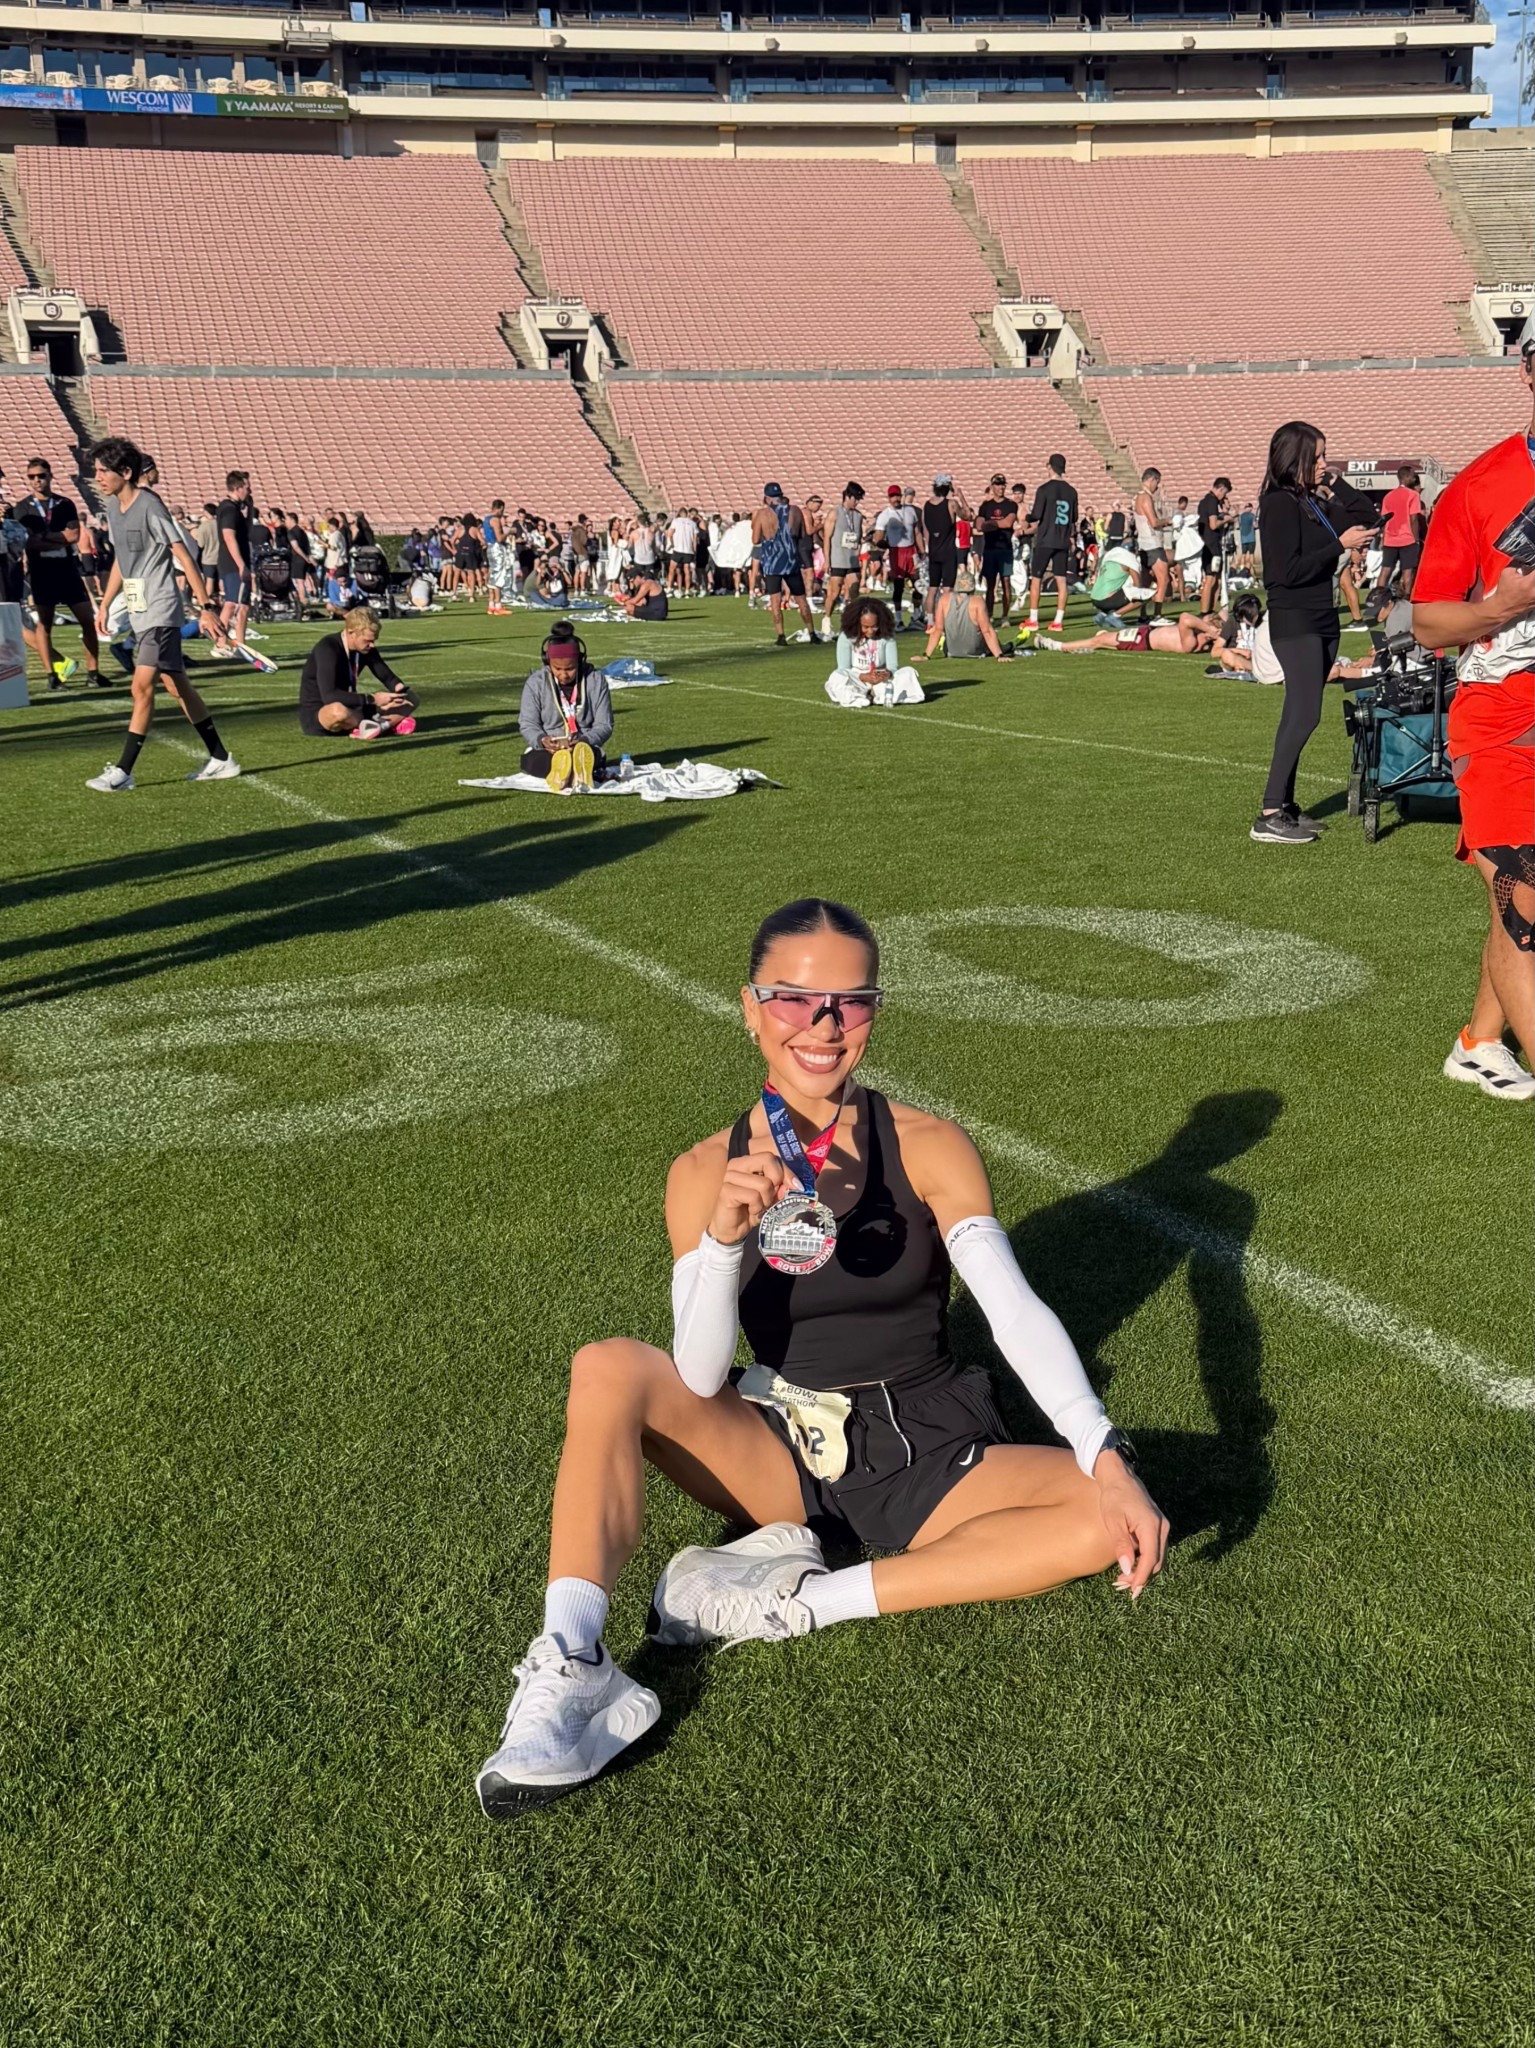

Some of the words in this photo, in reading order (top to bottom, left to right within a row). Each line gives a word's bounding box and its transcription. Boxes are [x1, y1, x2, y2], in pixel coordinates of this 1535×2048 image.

[106, 90, 169, 105] WESCOM
[137, 104, 169, 112] Financial
[559, 315, 569, 324] 17
[1347, 461, 1378, 472] EXIT
[1355, 478, 1373, 488] 15A
[776, 1260, 801, 1273] ROSE
[787, 1384, 818, 1402] BOWL
